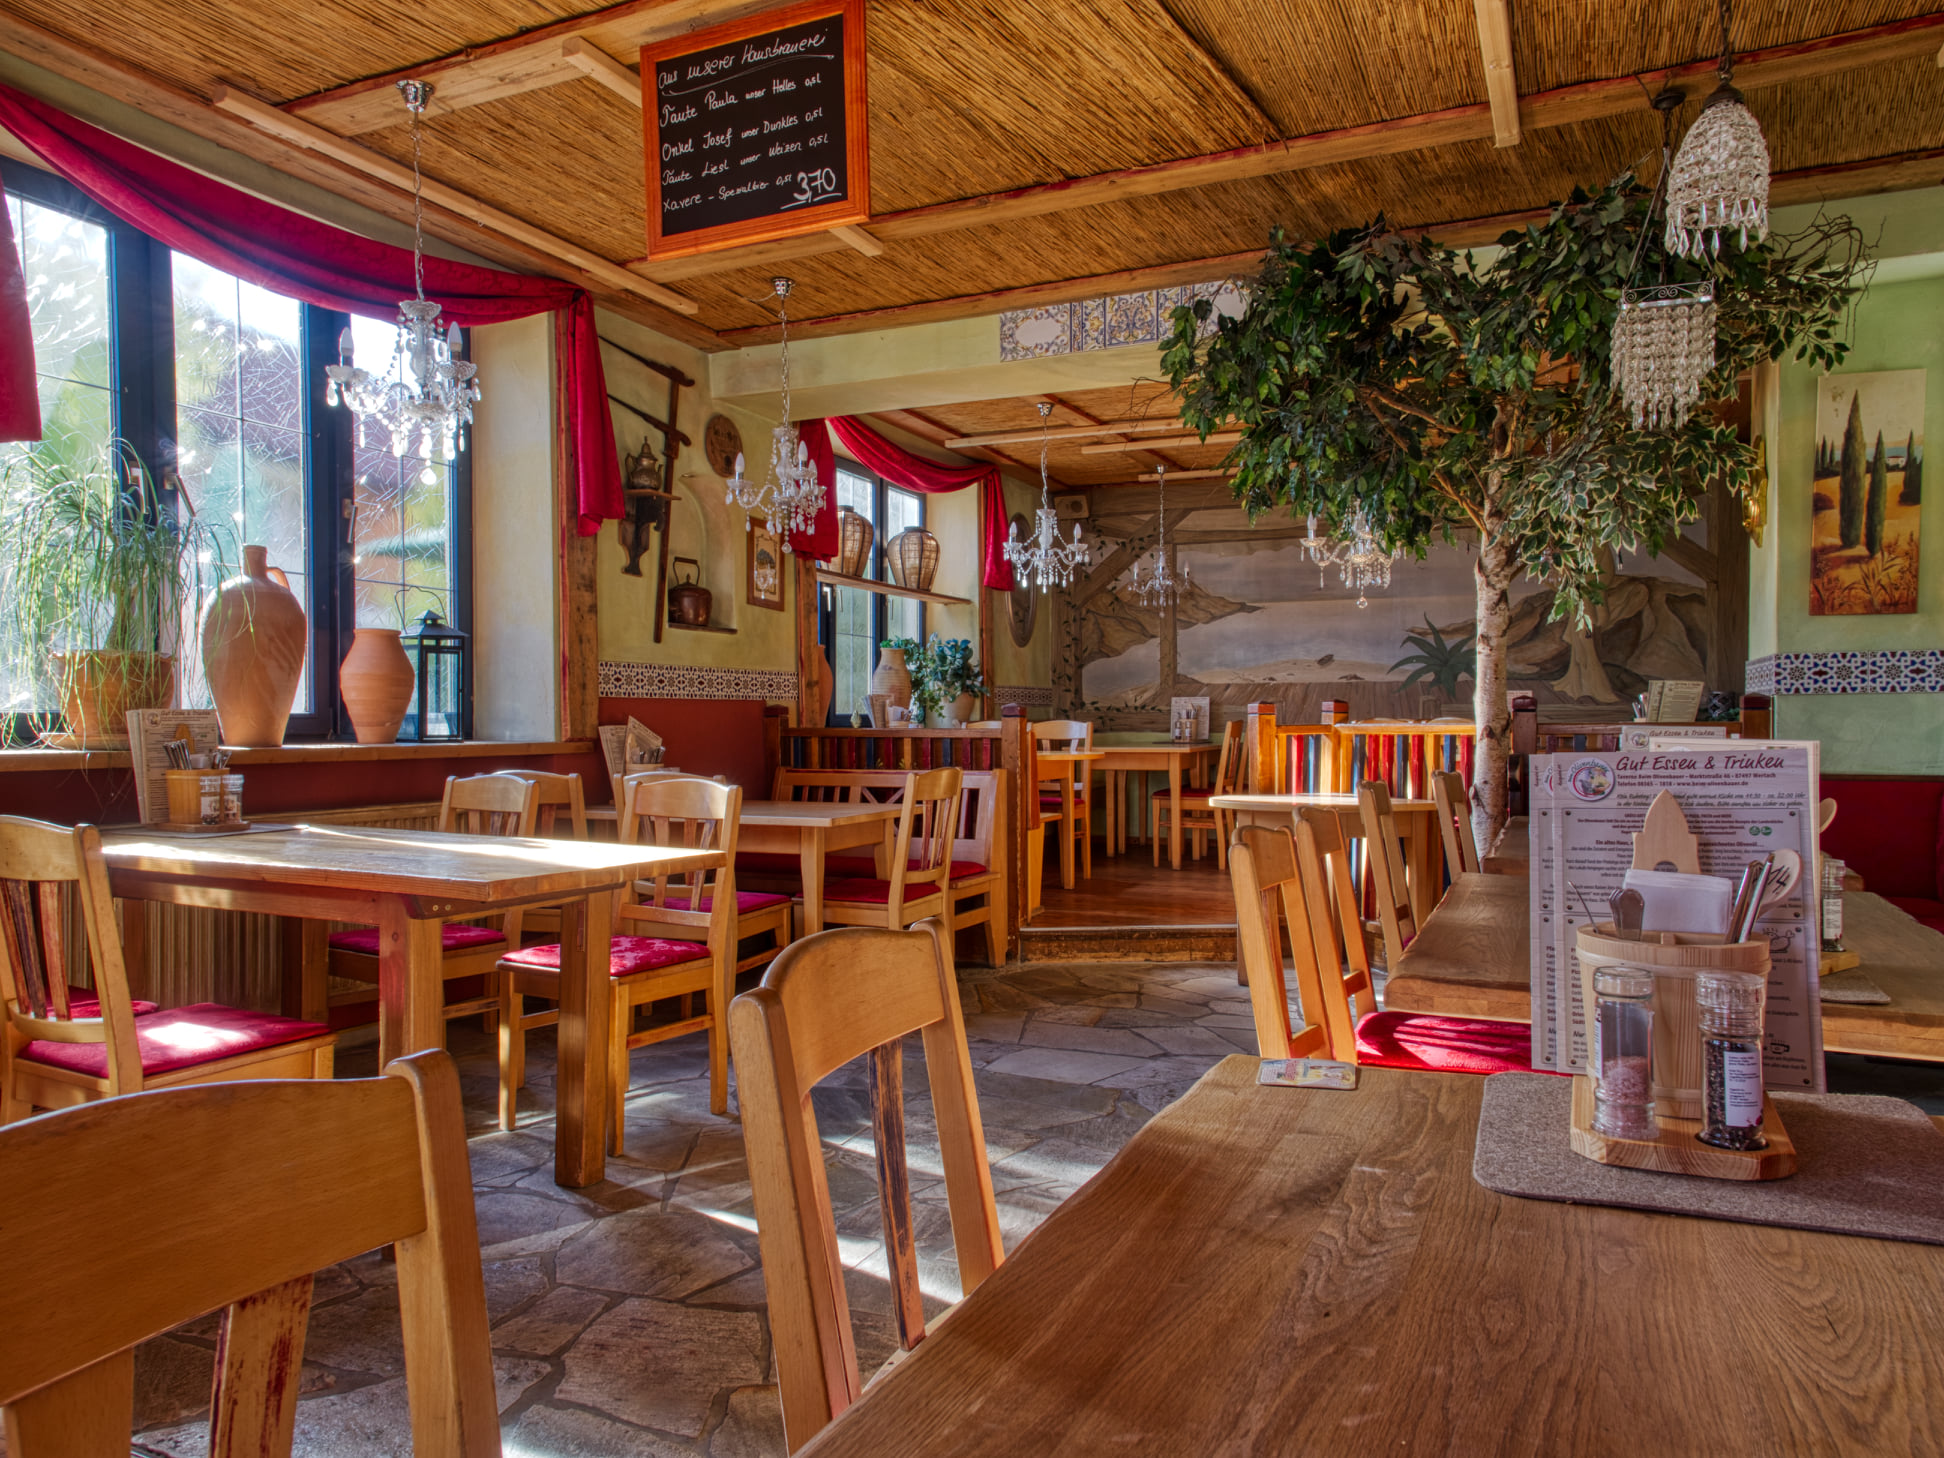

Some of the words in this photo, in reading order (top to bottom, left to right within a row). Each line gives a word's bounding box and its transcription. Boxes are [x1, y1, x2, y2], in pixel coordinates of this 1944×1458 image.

[686, 56, 736, 80] unserer
[704, 90, 738, 111] Paula
[745, 88, 766, 100] unser
[772, 78, 797, 95] Helles
[662, 139, 694, 161] Onkel
[703, 128, 732, 148] Josef
[741, 127, 759, 138] unser
[764, 114, 799, 133] Dunkles
[701, 160, 730, 177] Liesl
[740, 153, 761, 166] unser
[769, 141, 802, 157] Weizen
[793, 167, 836, 203] 3,70
[1616, 756, 1648, 770] Gut
[1652, 756, 1697, 770] Essen
[1704, 756, 1715, 769] &
[1724, 753, 1784, 769] Trinken
